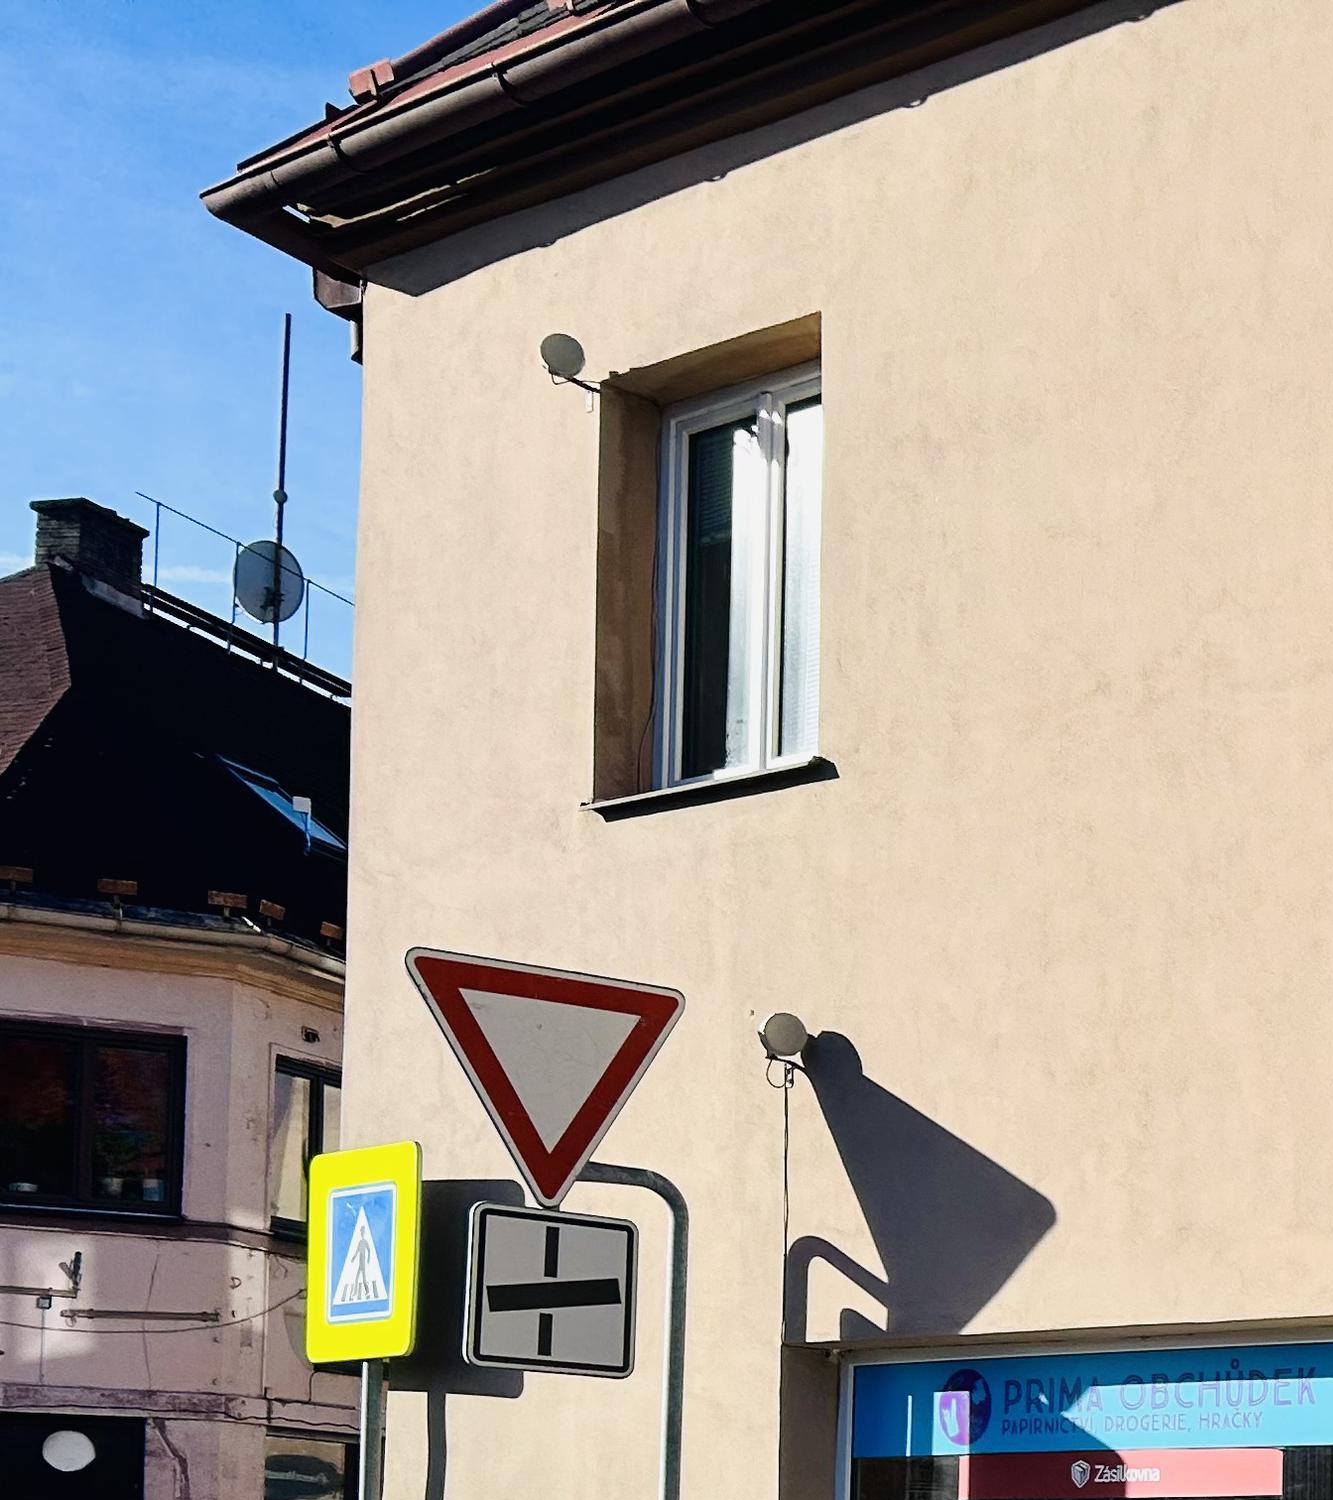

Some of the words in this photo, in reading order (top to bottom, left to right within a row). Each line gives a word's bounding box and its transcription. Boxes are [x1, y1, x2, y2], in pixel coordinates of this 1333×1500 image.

[1004, 1377, 1103, 1414] PRIMA
[1118, 1357, 1317, 1412] OBCHŮDEK
[1001, 1413, 1098, 1436] PAPÍRNICTVÍ,
[1104, 1411, 1192, 1433] DROGERIE,
[1199, 1407, 1264, 1430] HRAČKY
[1094, 1463, 1161, 1484] Zásilkovna
